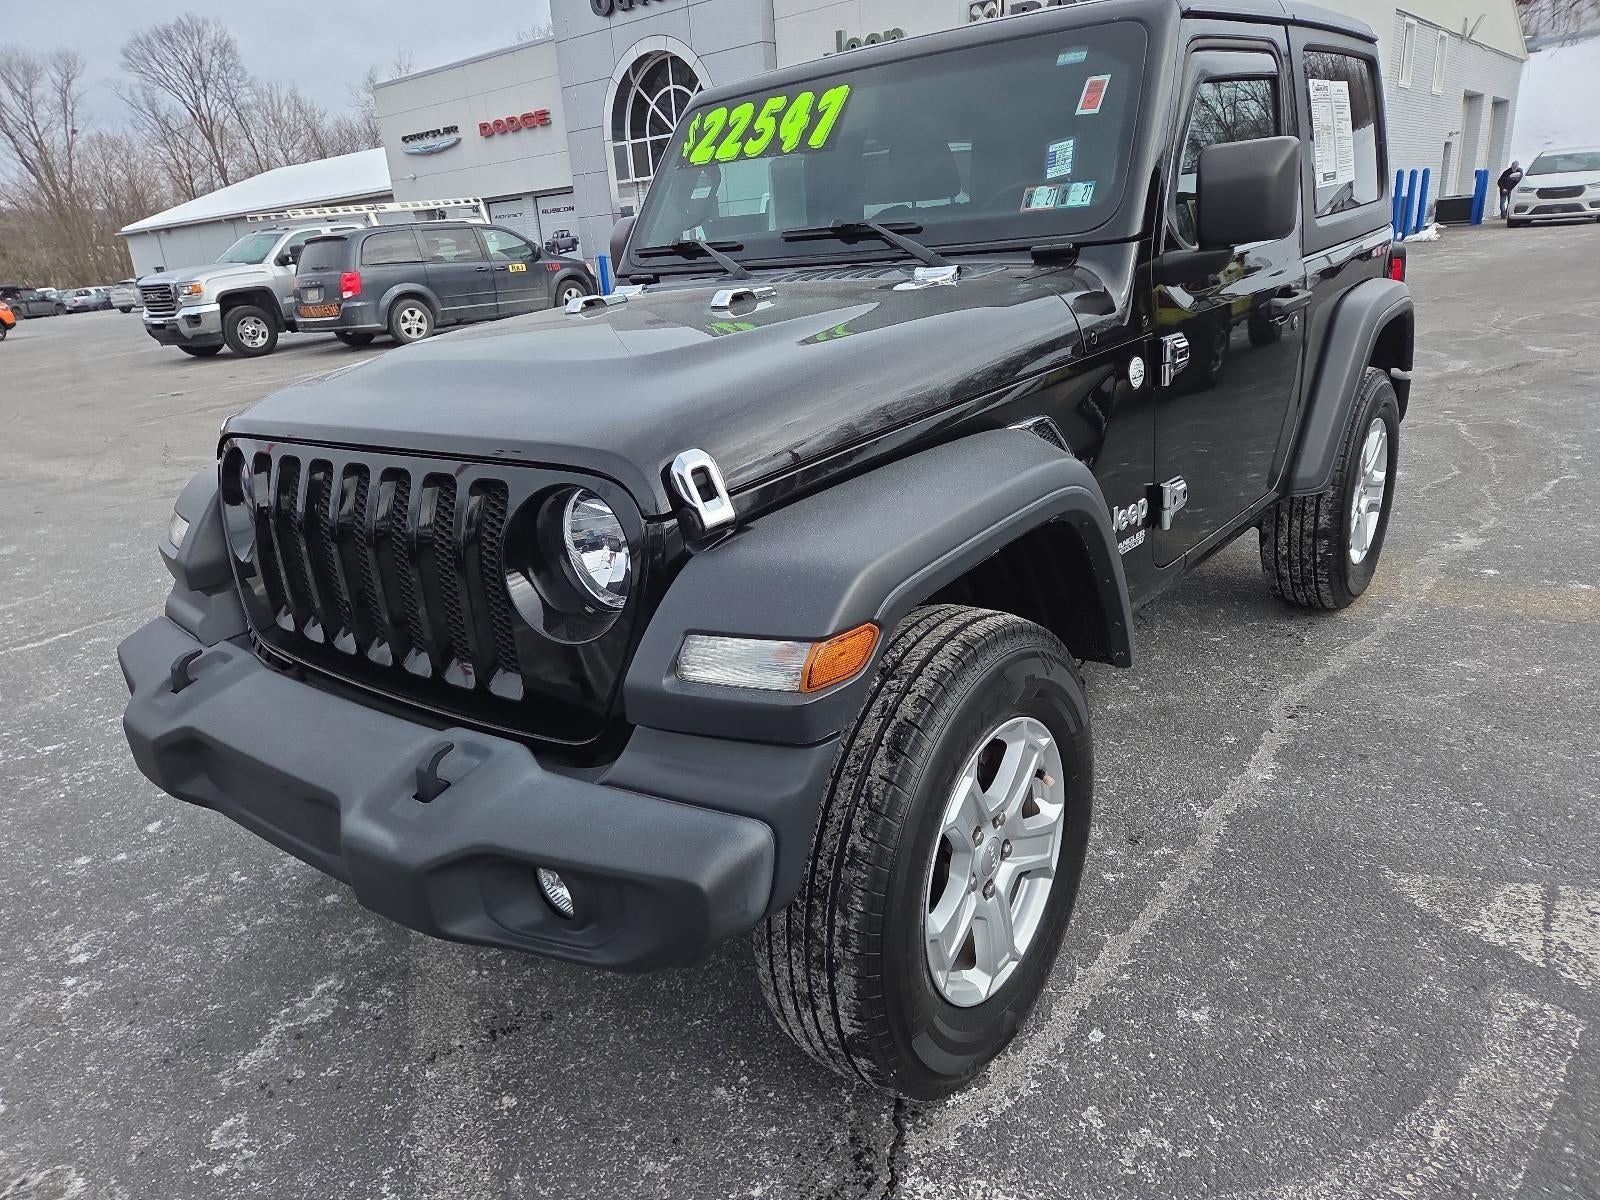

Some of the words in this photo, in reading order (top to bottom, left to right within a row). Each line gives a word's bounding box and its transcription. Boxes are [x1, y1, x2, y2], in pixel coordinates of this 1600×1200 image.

[478, 109, 552, 138] DODGE
[541, 205, 575, 215] RUBICON
[1112, 497, 1149, 534] Jeep
[1117, 529, 1146, 549] ANGLER
